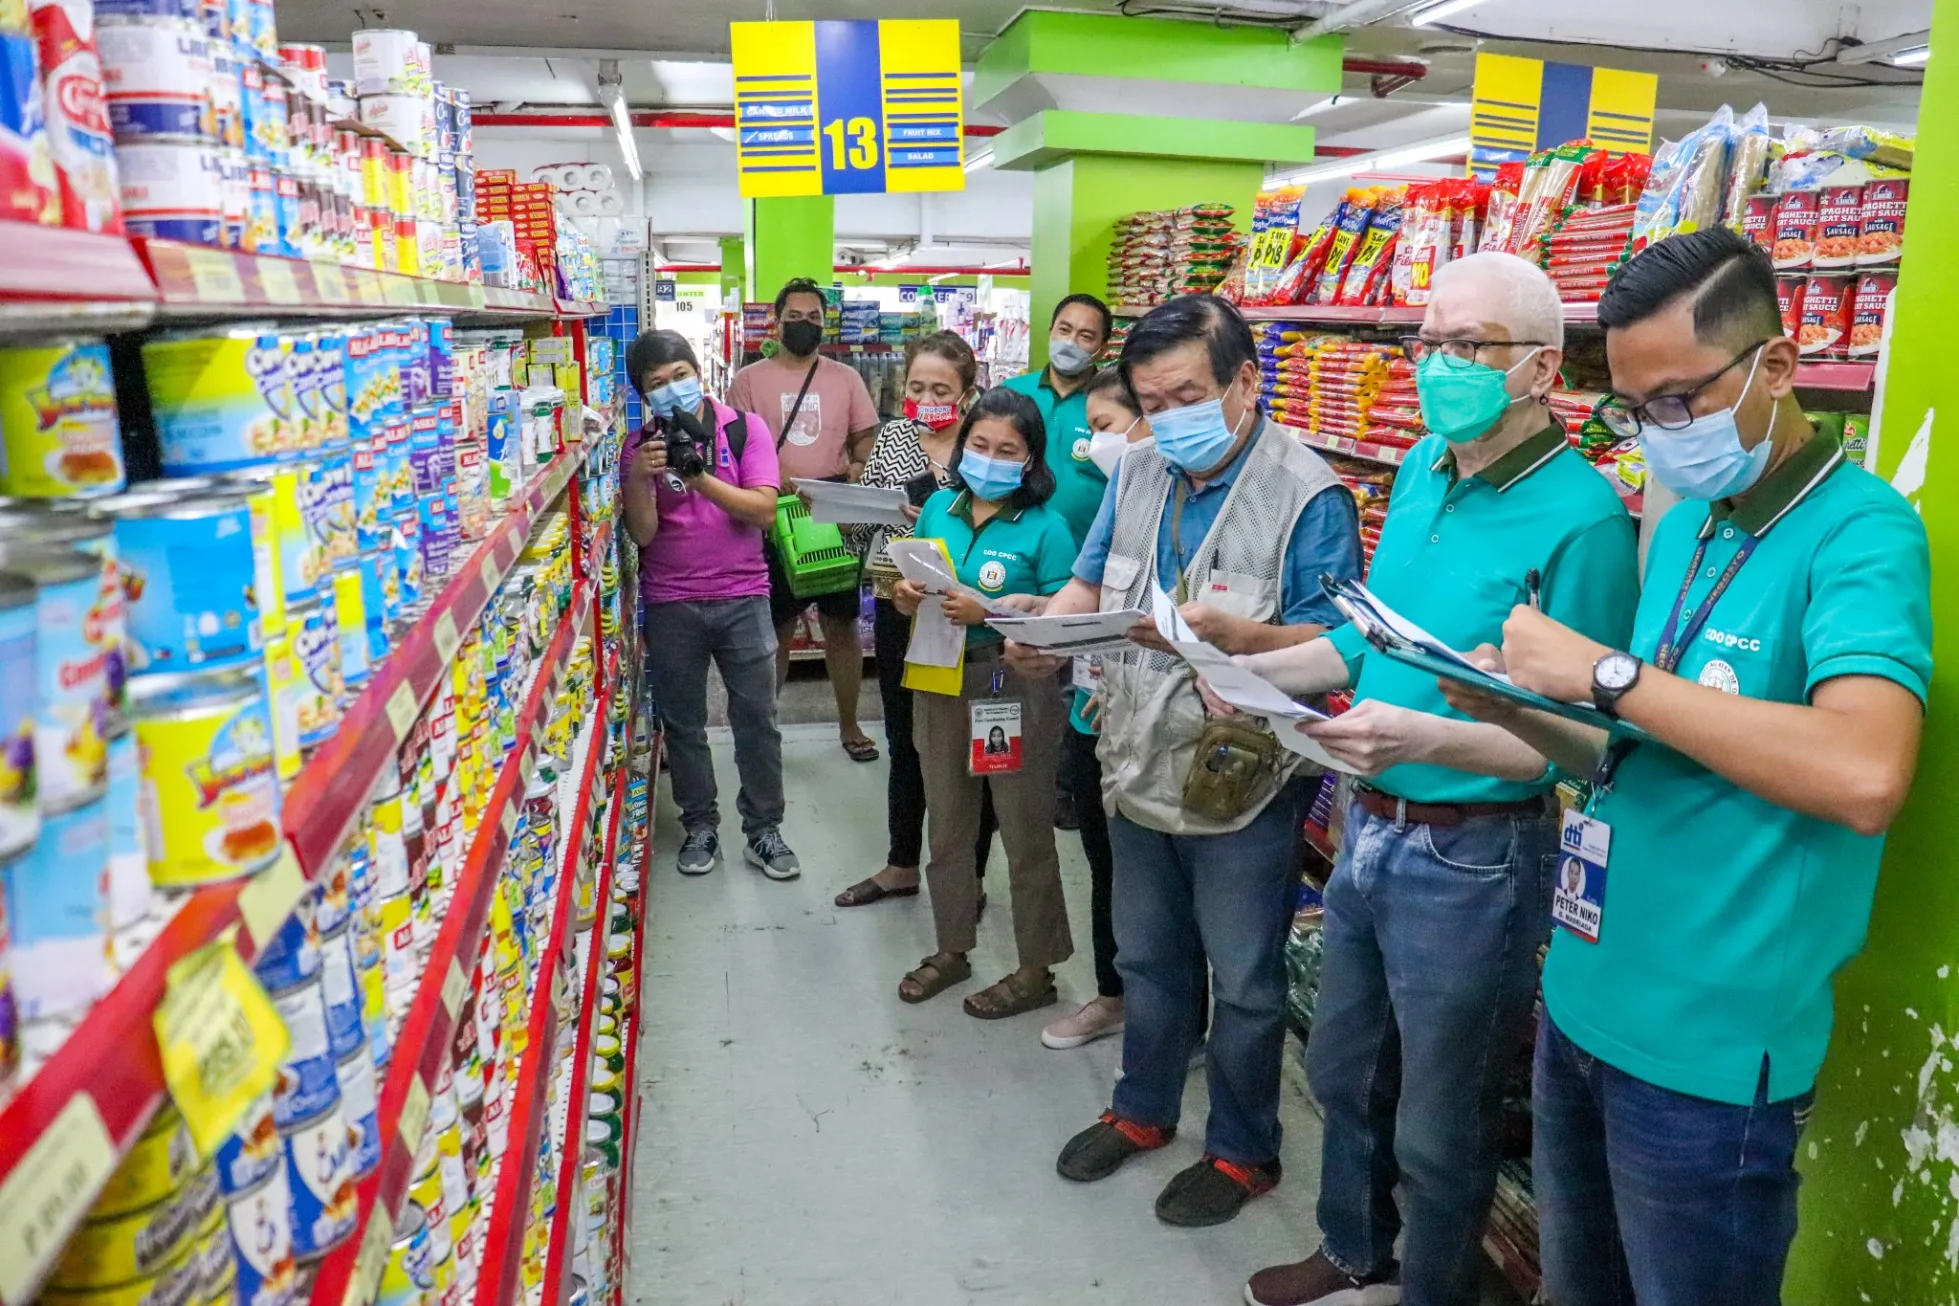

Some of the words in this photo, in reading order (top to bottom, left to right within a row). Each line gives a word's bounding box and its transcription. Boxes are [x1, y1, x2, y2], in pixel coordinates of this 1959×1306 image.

[926, 128, 941, 136] MIX
[823, 117, 879, 171] 13
[907, 152, 934, 160] SALAD
[1820, 207, 1861, 216] SPAGHET
[1878, 209, 1905, 217] SAUC
[1841, 214, 1861, 222] SAU
[1826, 227, 1857, 237] SAUSAGE
[1864, 222, 1894, 233] SAUSAGE
[1270, 231, 1287, 240] SAVE
[1337, 234, 1350, 246] SAVE
[1372, 231, 1388, 241] SAV
[676, 301, 693, 312] 105
[919, 405, 952, 413] ONGBONG
[983, 549, 997, 557] CDO
[1564, 821, 1584, 847] dti
[1555, 894, 1578, 916] PETER
[1579, 906, 1599, 926] NIKO
